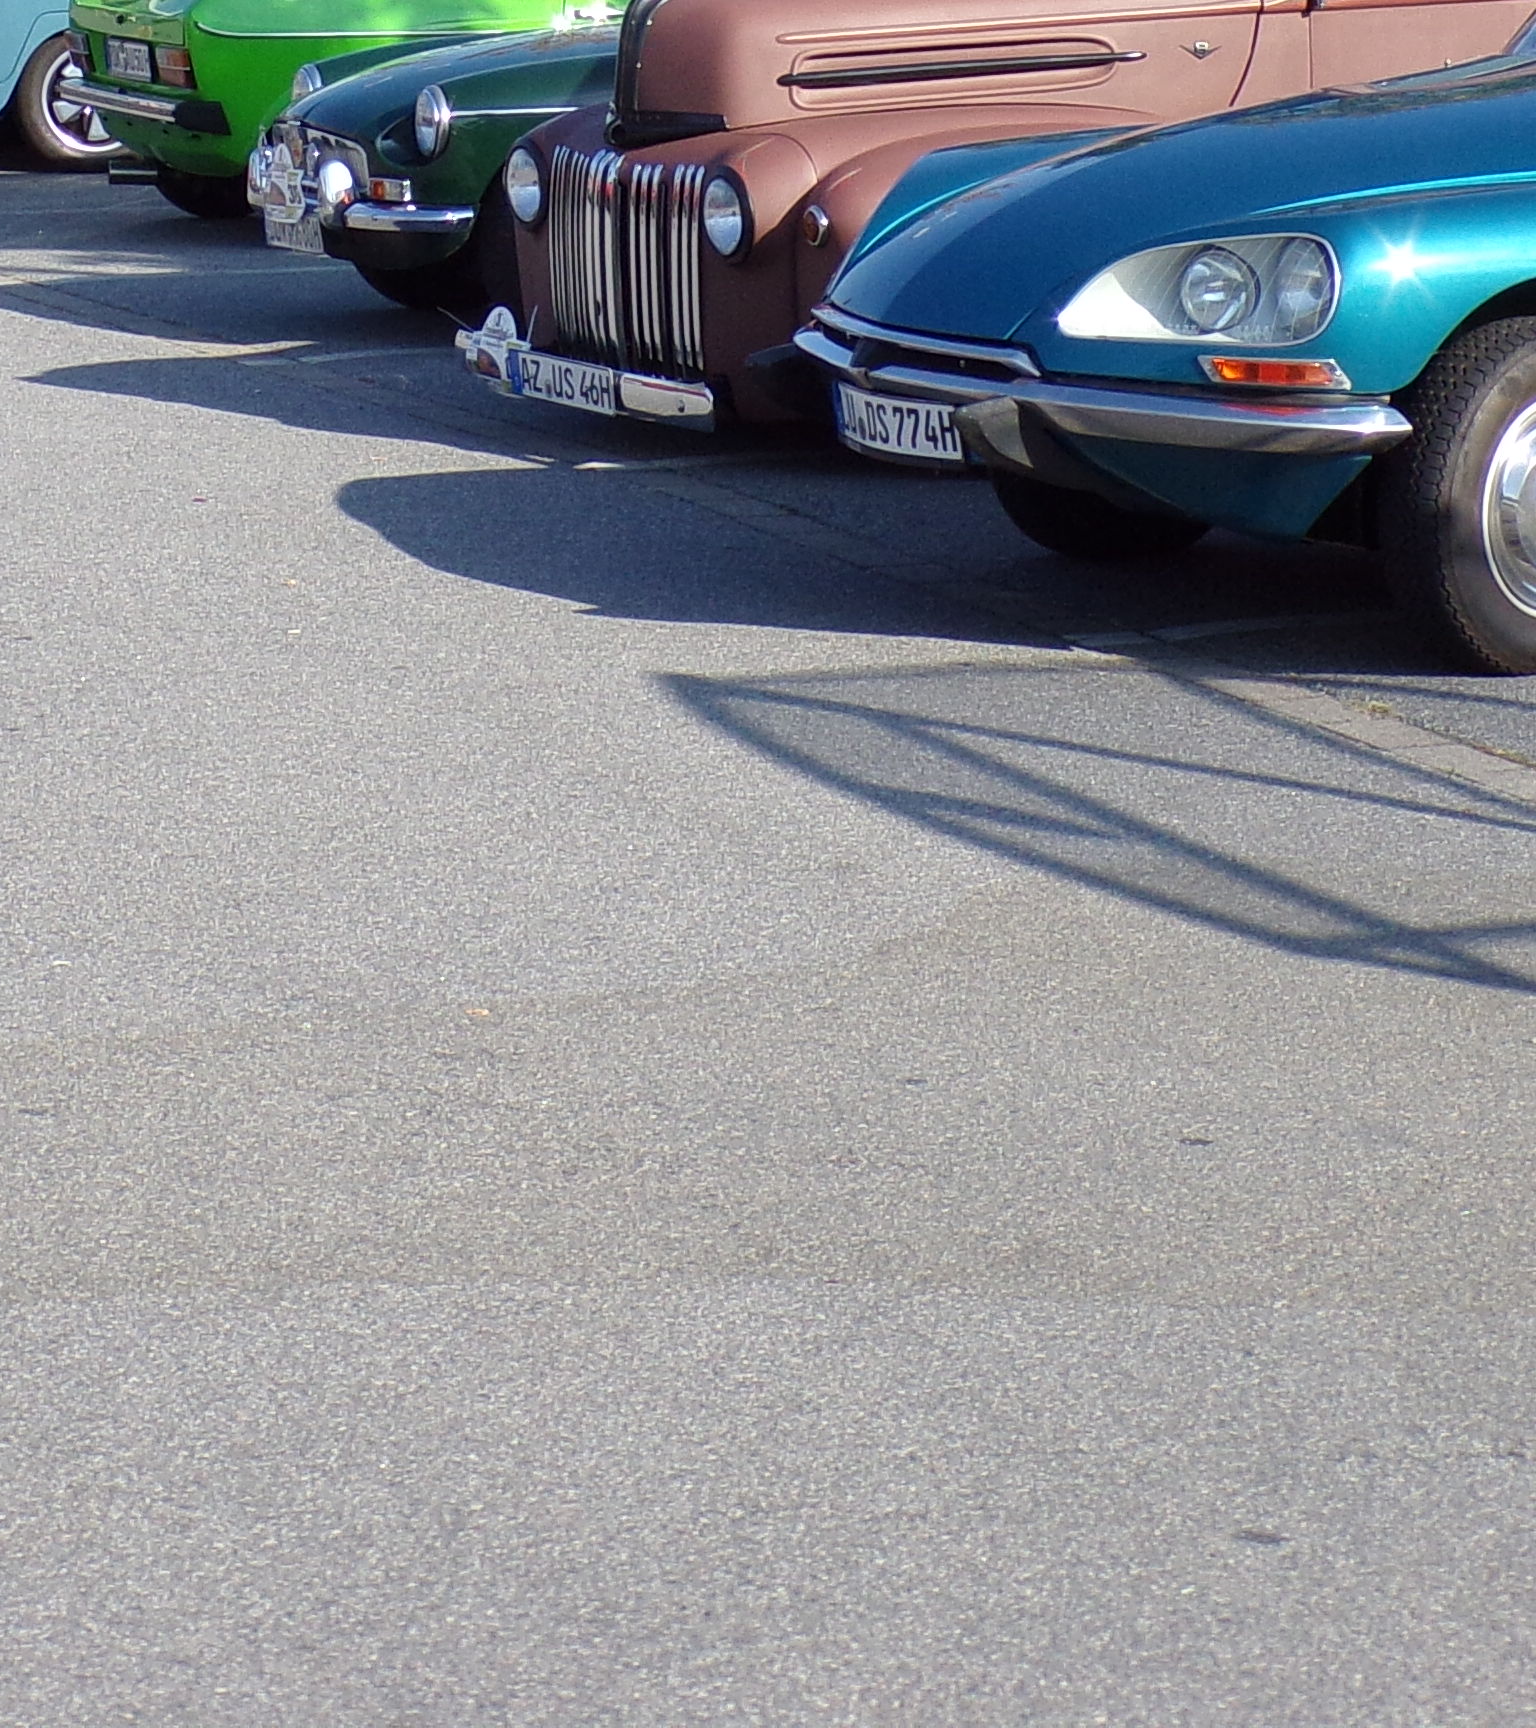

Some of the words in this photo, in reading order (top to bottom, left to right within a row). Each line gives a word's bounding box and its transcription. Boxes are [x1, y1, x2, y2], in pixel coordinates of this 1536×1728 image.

[521, 357, 543, 392] AZ
[552, 364, 575, 400] US
[580, 374, 612, 409] 46H
[865, 401, 890, 444] DS
[892, 406, 958, 452] 774H
